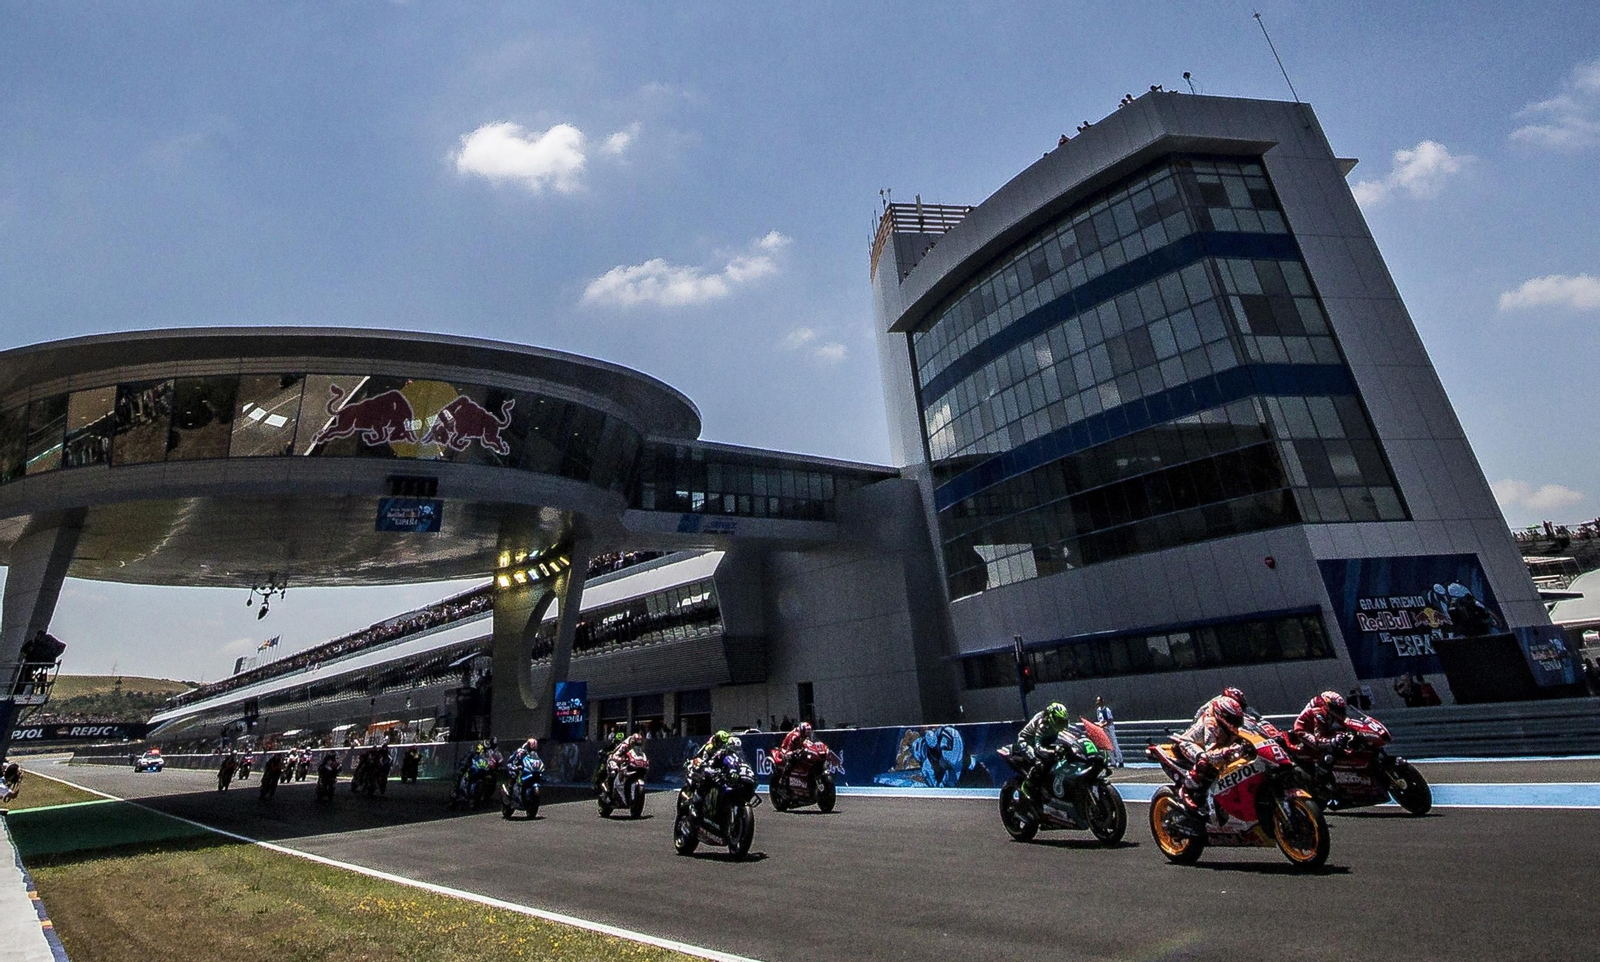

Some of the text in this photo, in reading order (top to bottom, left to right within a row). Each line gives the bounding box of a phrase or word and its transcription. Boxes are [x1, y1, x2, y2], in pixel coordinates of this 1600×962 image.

[1359, 596, 1426, 610] GRAN PREMIO
[1379, 629, 1444, 656] DE ESPA
[11, 729, 43, 740] PSOL
[1217, 763, 1260, 791] REPSOL
